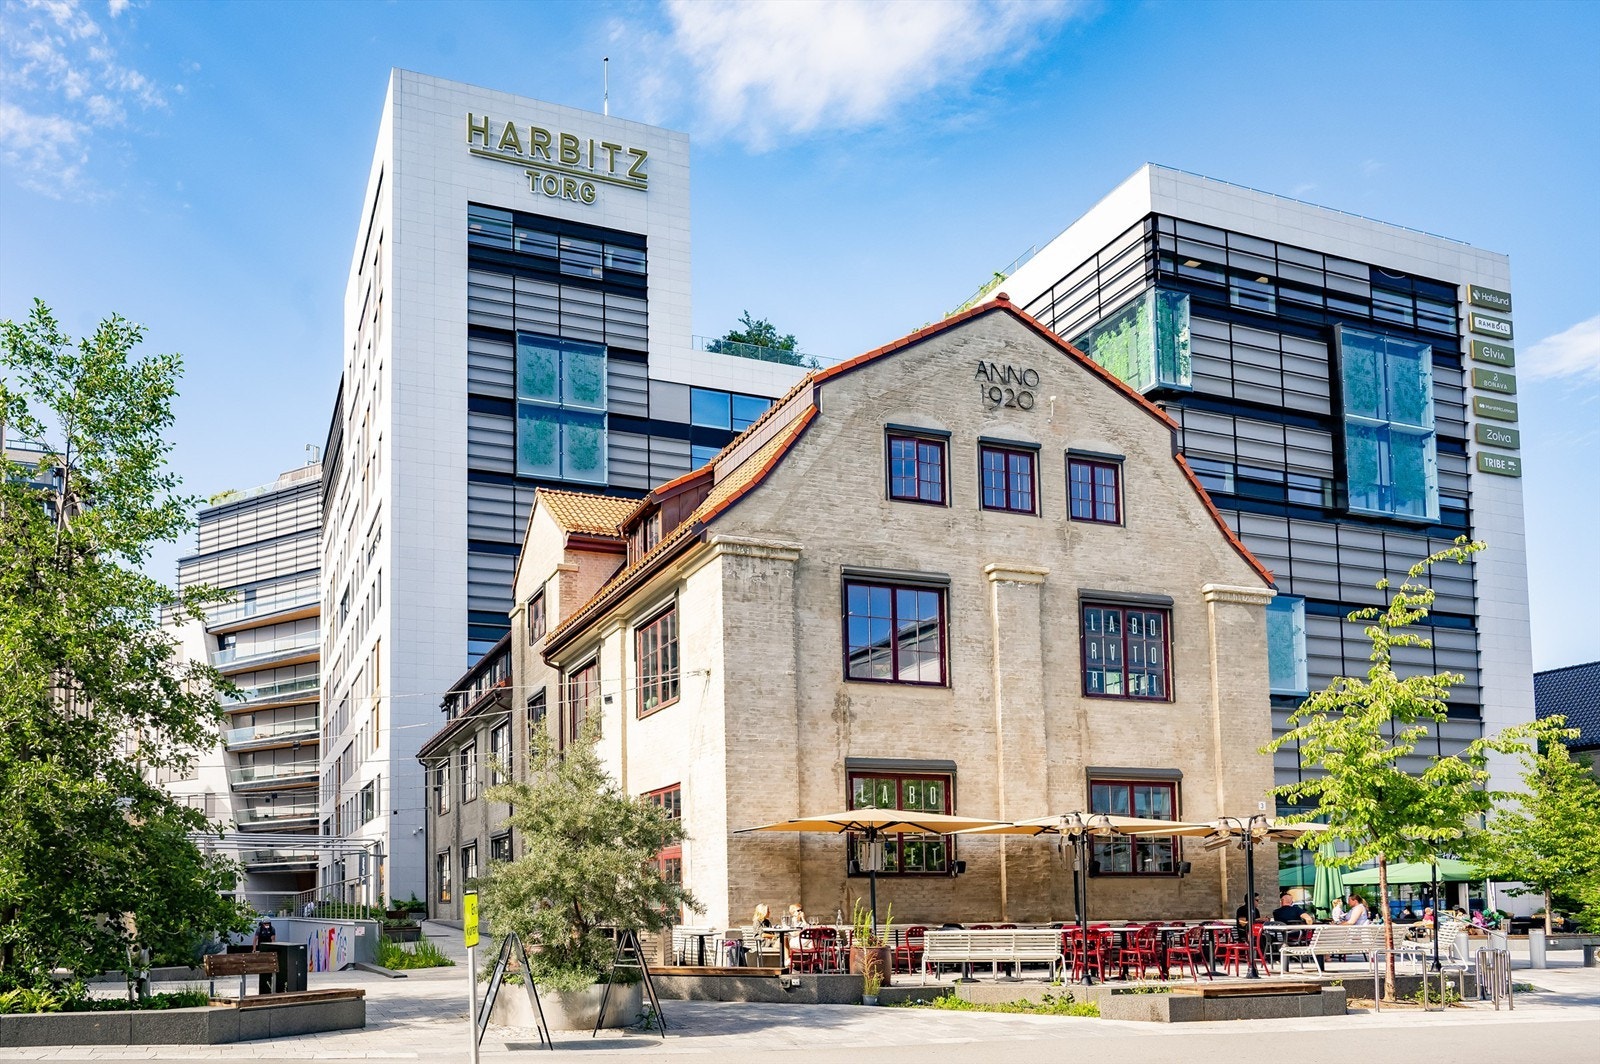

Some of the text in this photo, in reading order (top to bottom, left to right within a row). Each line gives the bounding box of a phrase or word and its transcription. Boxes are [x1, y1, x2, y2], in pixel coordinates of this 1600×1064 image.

[466, 112, 649, 181] HARBITZ
[524, 169, 596, 205] TORG
[1481, 292, 1509, 306] Hafslund
[975, 360, 1039, 387] ANNO
[1483, 380, 1507, 390] BONAVA
[980, 383, 1035, 411] 1920
[1486, 428, 1511, 443] Zolva
[1484, 457, 1506, 470] TRIBE
[1090, 613, 1155, 636] LABO
[860, 784, 937, 805] LABO
